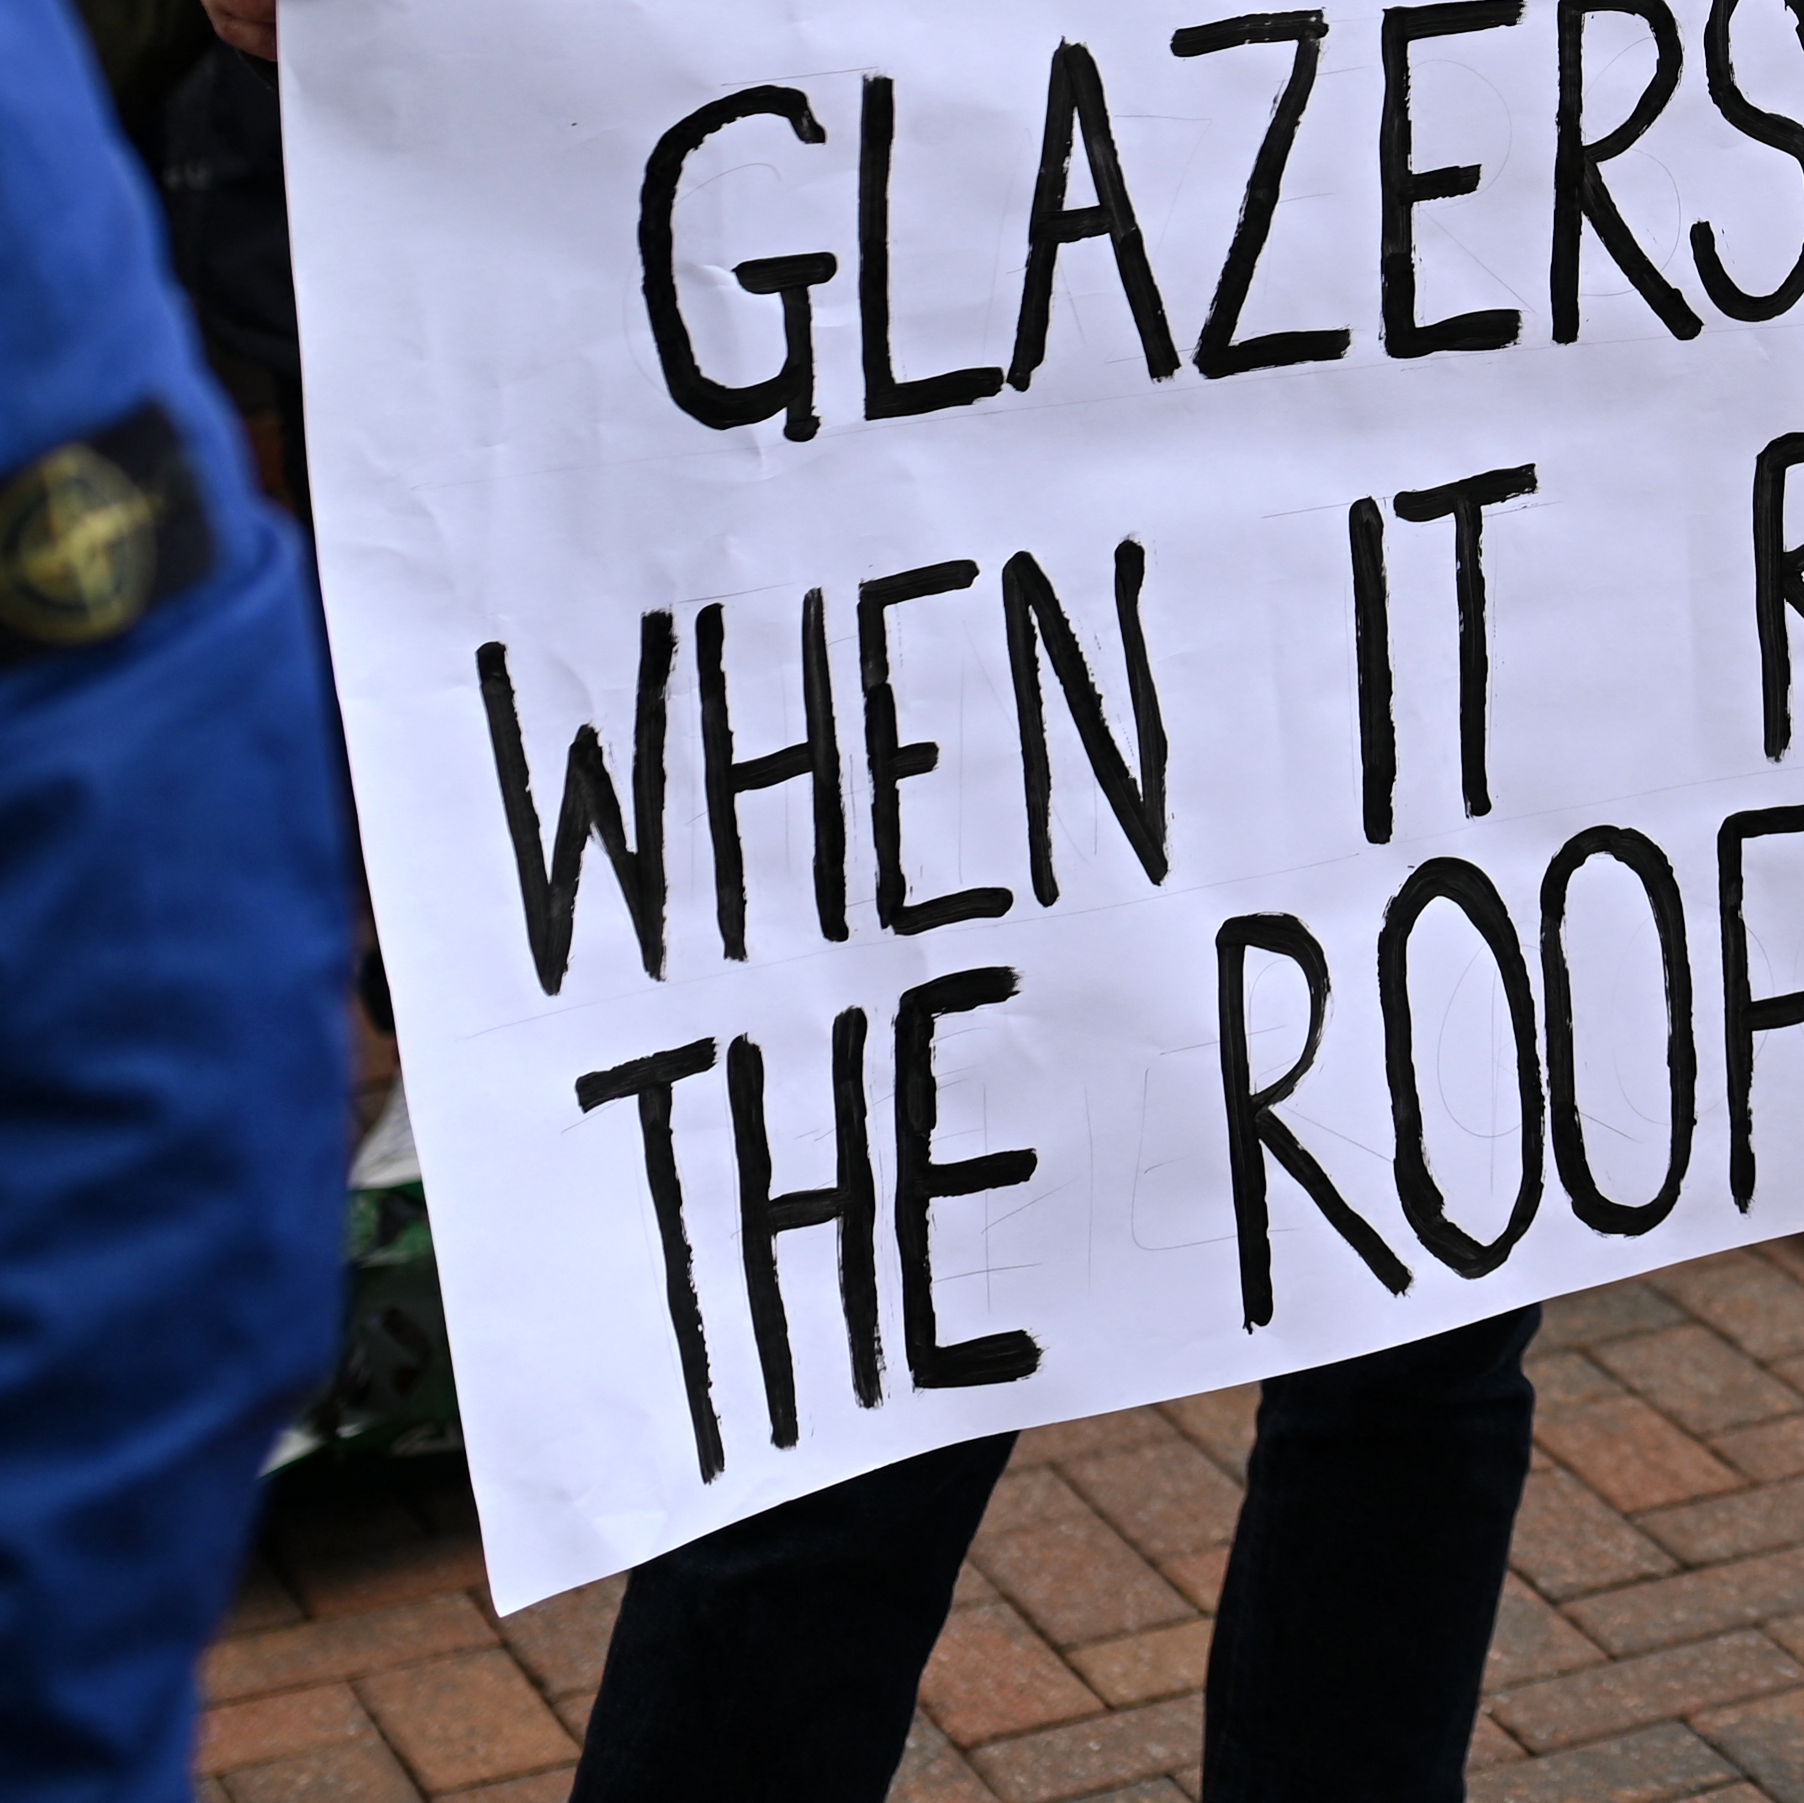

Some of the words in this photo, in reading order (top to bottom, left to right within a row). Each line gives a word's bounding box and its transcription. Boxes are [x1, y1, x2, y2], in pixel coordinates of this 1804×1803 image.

[475, 537, 1170, 997] WHEN
[1347, 462, 1539, 846] IT
[574, 965, 1044, 1485] THE
